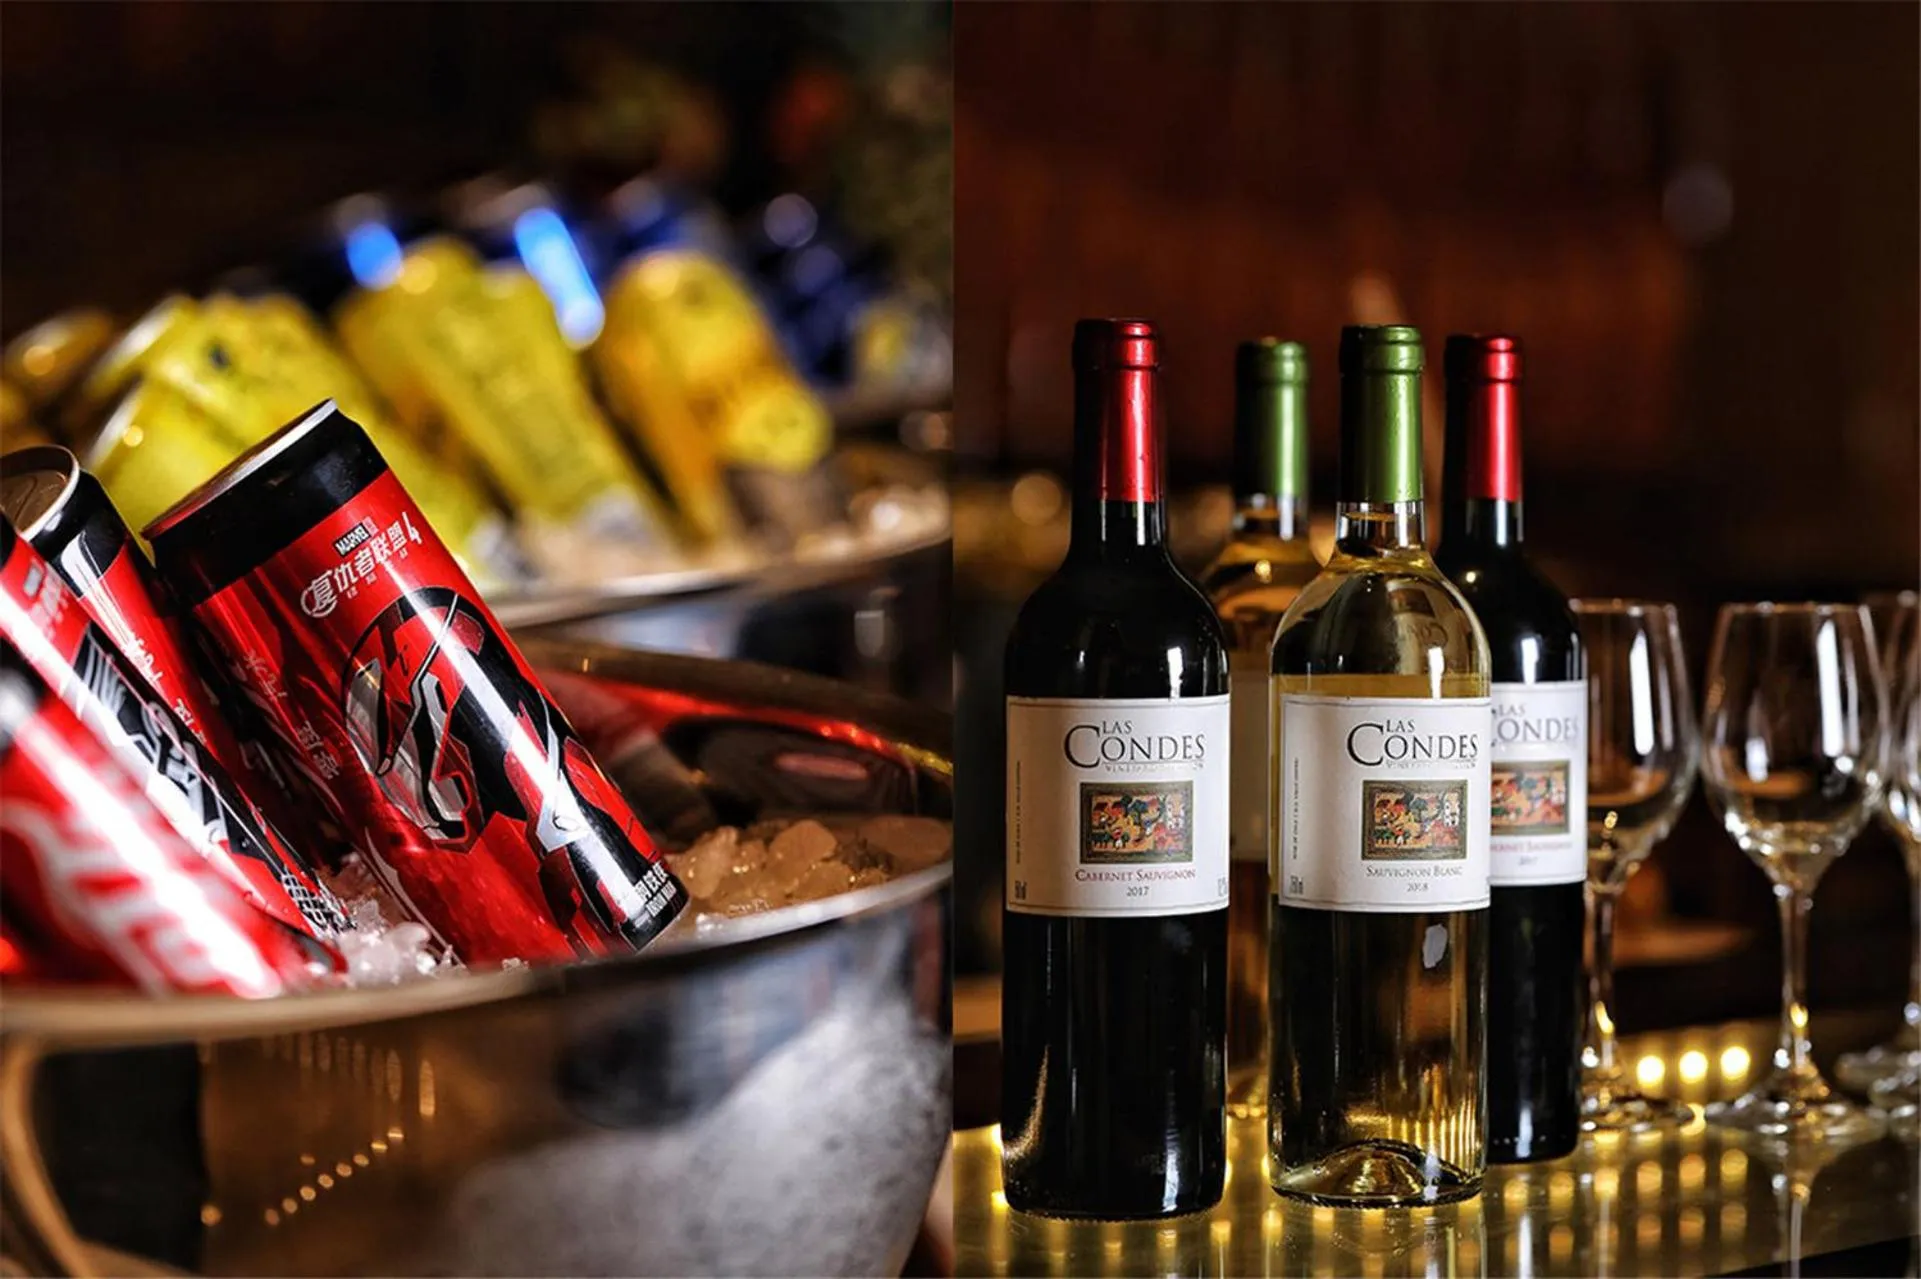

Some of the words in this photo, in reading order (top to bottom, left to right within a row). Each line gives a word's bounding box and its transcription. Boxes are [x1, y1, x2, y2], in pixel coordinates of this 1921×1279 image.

[334, 524, 370, 556] MARVEL
[1498, 703, 1528, 717] LAS
[1102, 720, 1132, 735] LAS
[1386, 719, 1415, 733] LAS
[1491, 708, 1579, 747] ONDES
[1126, 885, 1150, 897] 2017
